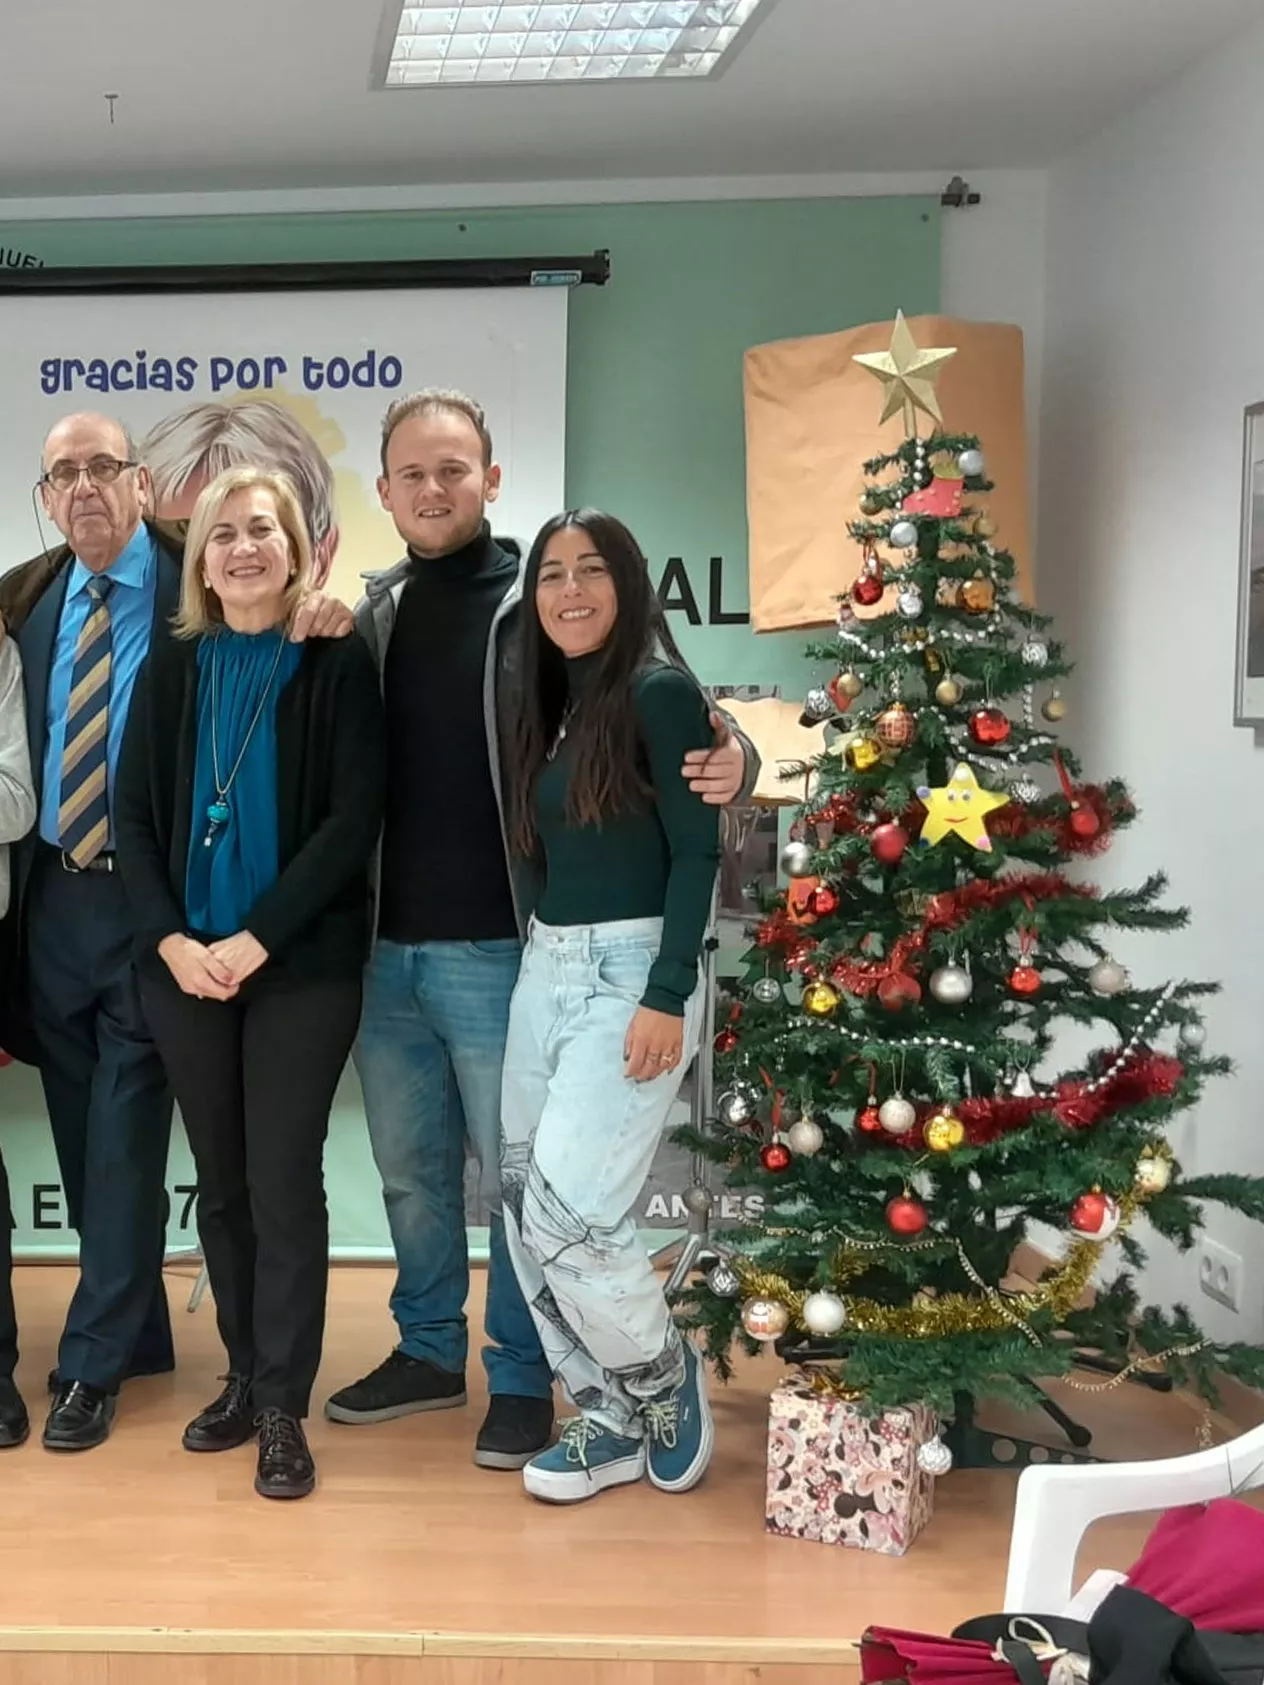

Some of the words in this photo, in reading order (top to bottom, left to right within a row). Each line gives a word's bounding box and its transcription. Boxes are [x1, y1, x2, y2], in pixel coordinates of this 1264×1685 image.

[40, 350, 198, 395] gracias
[210, 356, 287, 392] por
[302, 349, 402, 391] todo
[644, 1194, 765, 1219] ANES
